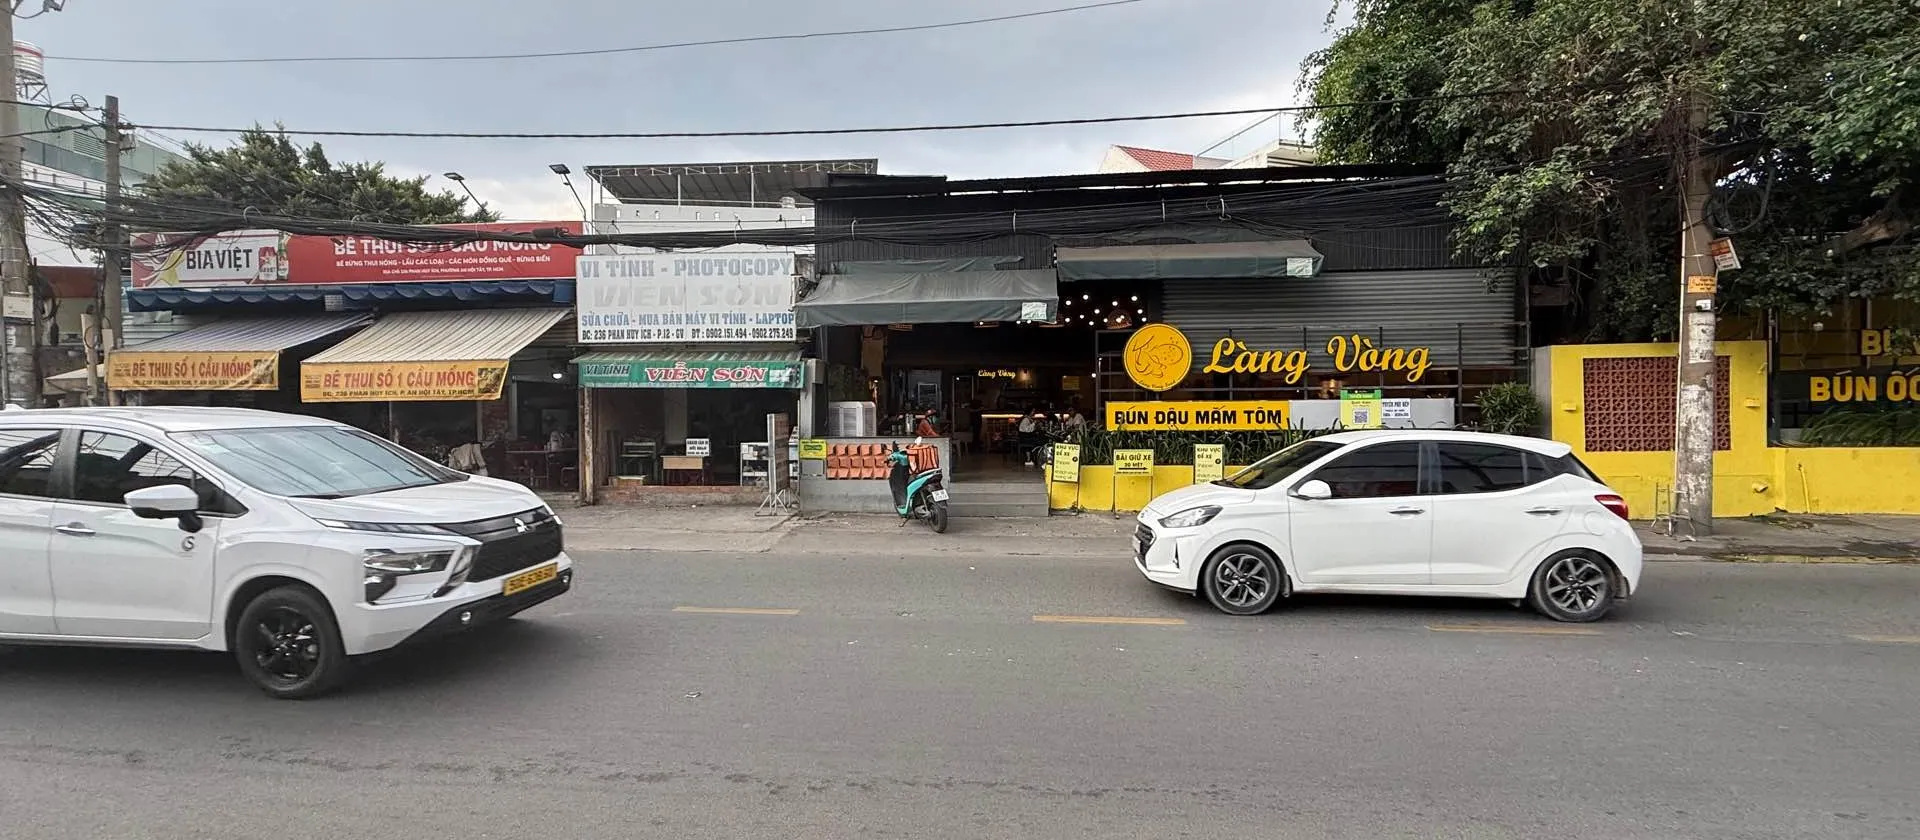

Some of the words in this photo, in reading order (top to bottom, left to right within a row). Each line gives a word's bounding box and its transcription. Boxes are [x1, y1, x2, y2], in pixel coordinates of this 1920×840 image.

[334, 237, 356, 255] BÊ
[216, 246, 252, 272] VIỆT
[415, 256, 428, 265] CÁC
[448, 256, 462, 265] CÁC
[580, 261, 599, 278] VI
[674, 258, 792, 277] PHOTOCOPY
[582, 312, 601, 326] SỬA
[604, 312, 630, 326] CHỮA
[639, 313, 660, 325] MUA
[662, 310, 682, 325] BÁN
[685, 310, 705, 325] MÁY
[710, 313, 719, 324] VI
[722, 310, 746, 324] TÍNH
[756, 311, 794, 325] LAPTOP
[608, 328, 625, 339] PHAN
[627, 329, 639, 340] HUY
[657, 328, 671, 339] P.12
[676, 328, 684, 339] GV
[706, 327, 747, 339] 0902.151.494
[132, 360, 145, 377] BÊ
[149, 362, 171, 377] THUI
[174, 356, 188, 377] SỐ
[199, 356, 219, 377] CẦU
[584, 364, 601, 375] VI
[603, 362, 630, 374] TÍNH
[1203, 337, 1309, 384] Làng
[1327, 334, 1432, 382] Vòng
[323, 371, 339, 388] BÊ
[344, 373, 373, 388] THUI
[376, 367, 393, 387] SỐ
[406, 365, 432, 387] CẦU
[435, 365, 475, 387] MỐNG
[646, 361, 708, 382] VIỄN
[713, 364, 768, 382] SƠN
[1808, 369, 1877, 402] BÚN
[1114, 406, 1148, 424] BÚN
[1154, 407, 1188, 427] ĐẬU
[1195, 405, 1237, 424] MẮM
[1243, 406, 1282, 424] TÔM
[1129, 453, 1141, 461] GIỮ
